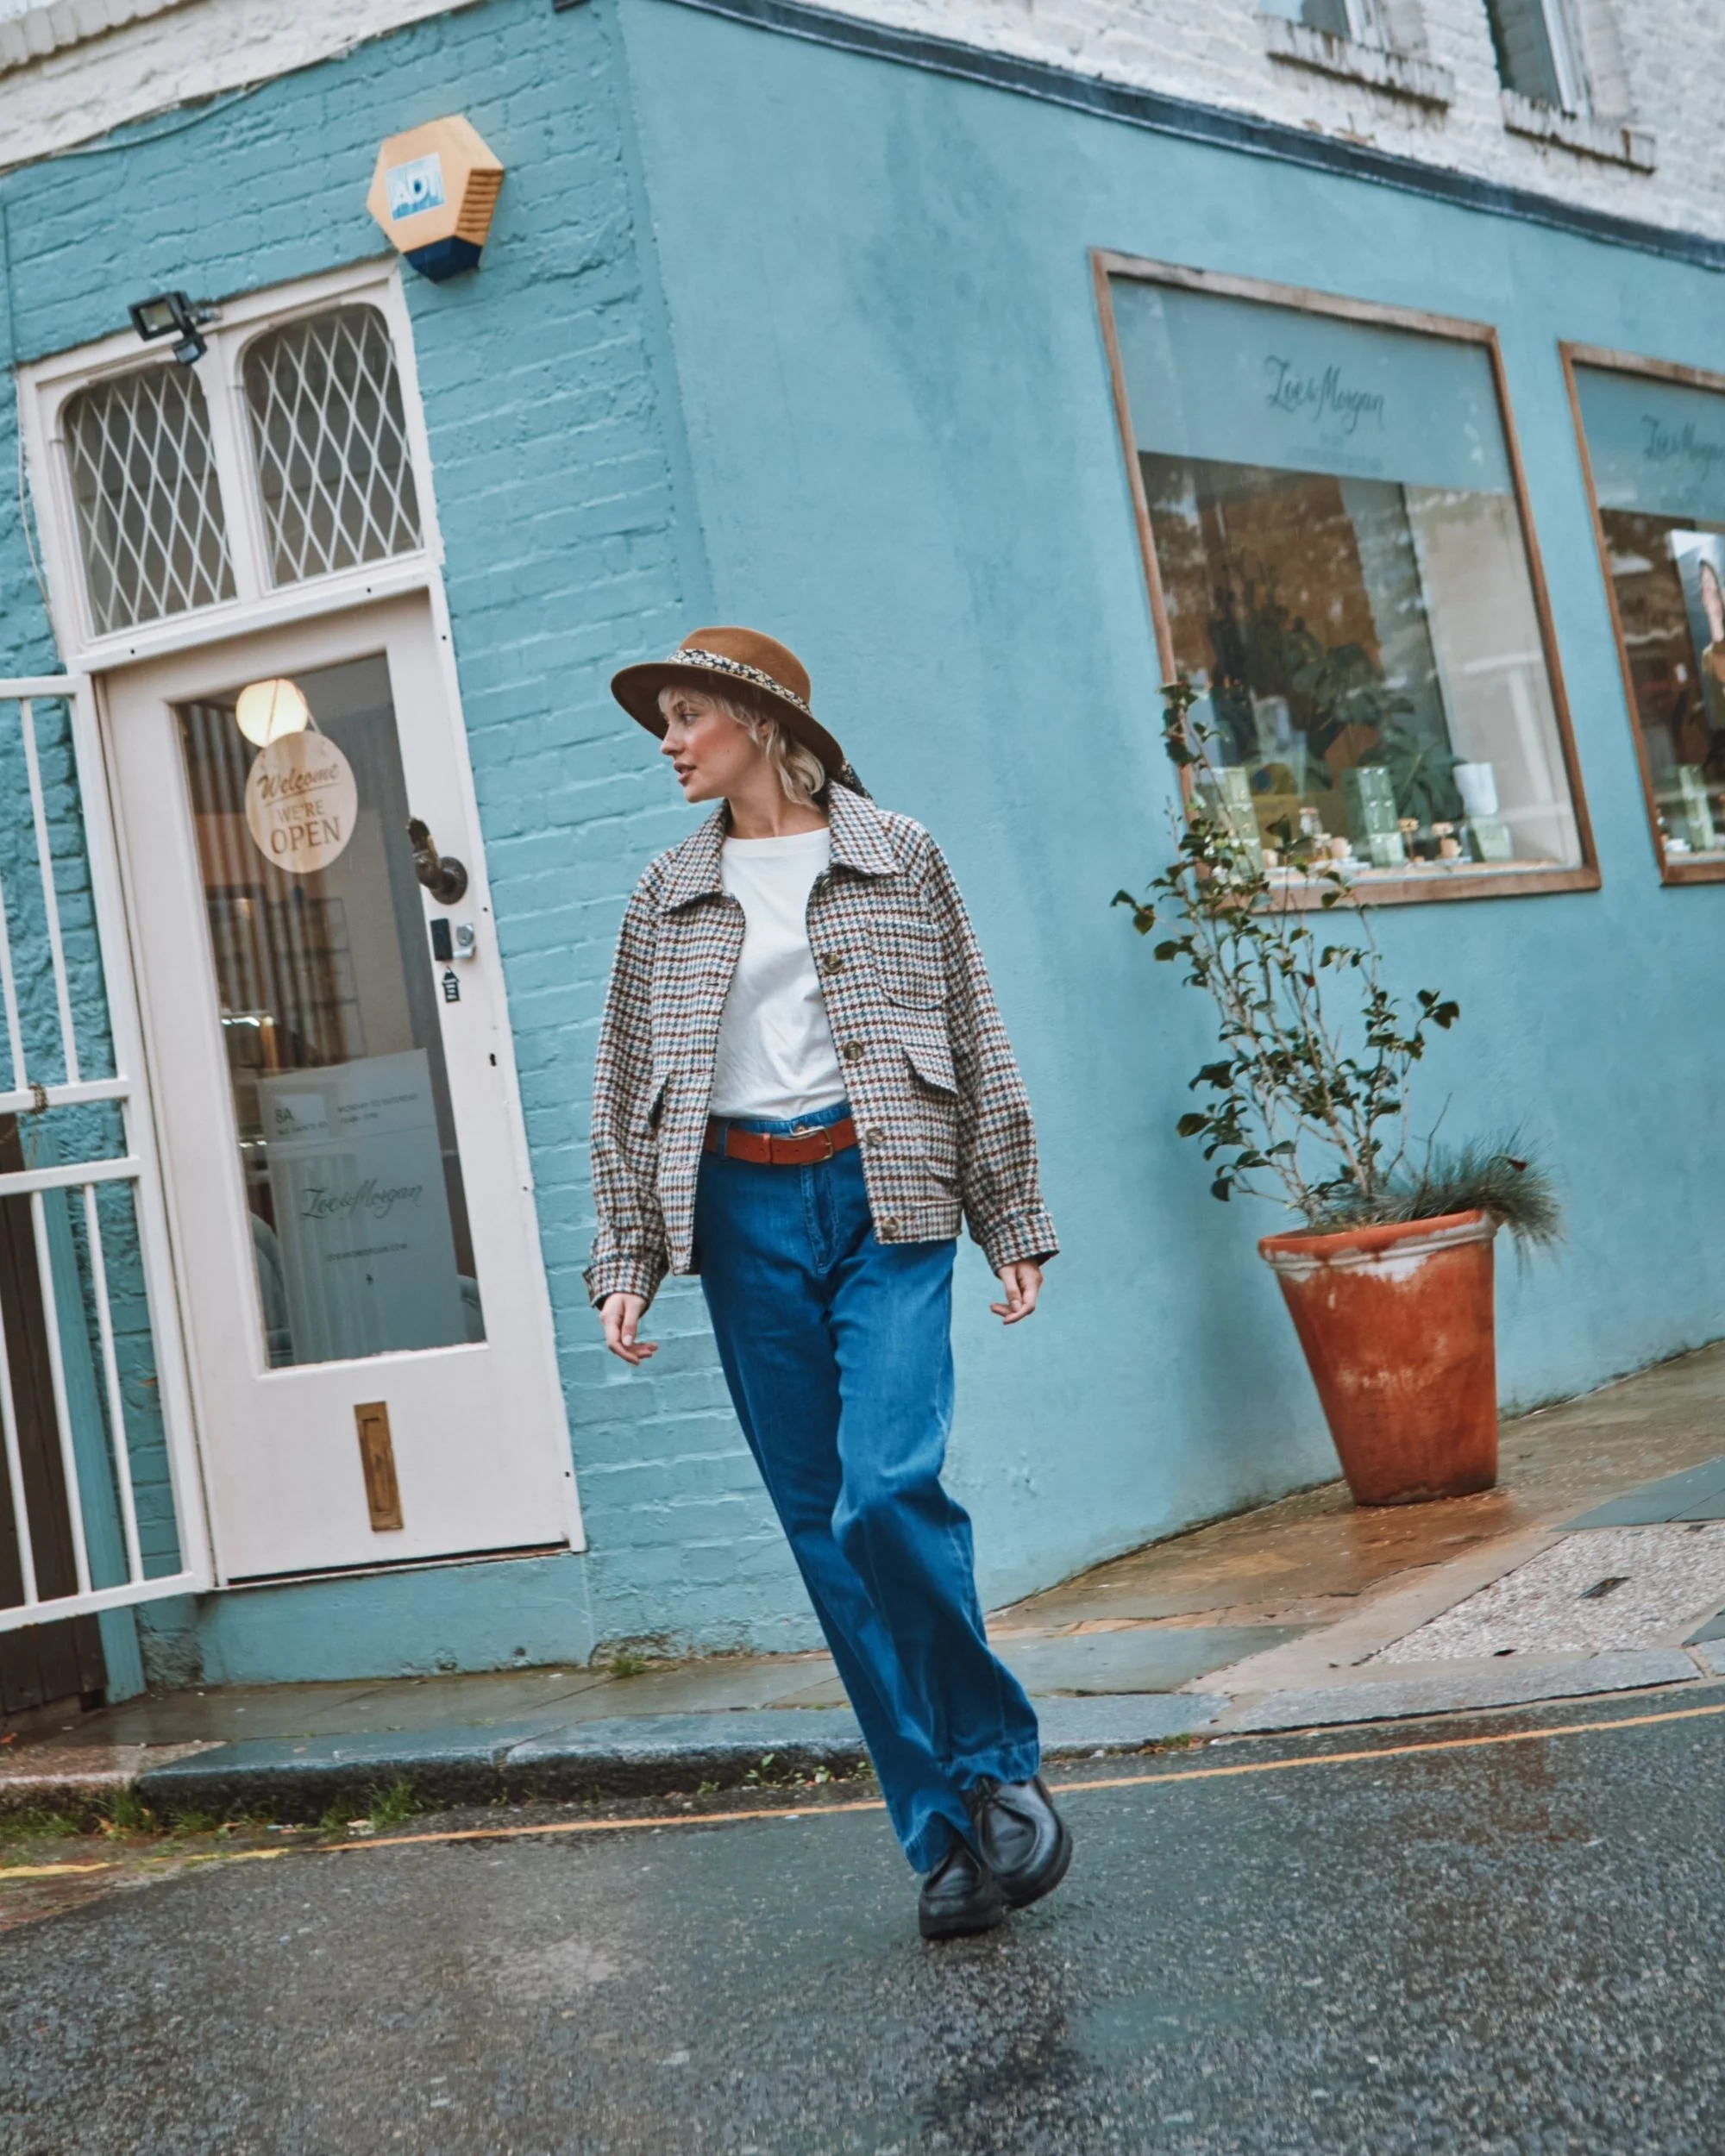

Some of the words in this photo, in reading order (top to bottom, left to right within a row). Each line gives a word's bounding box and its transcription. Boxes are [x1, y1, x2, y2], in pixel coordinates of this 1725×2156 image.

[392, 165, 441, 206] ADT
[256, 764, 339, 800] Welcome
[271, 816, 342, 854] OPEN
